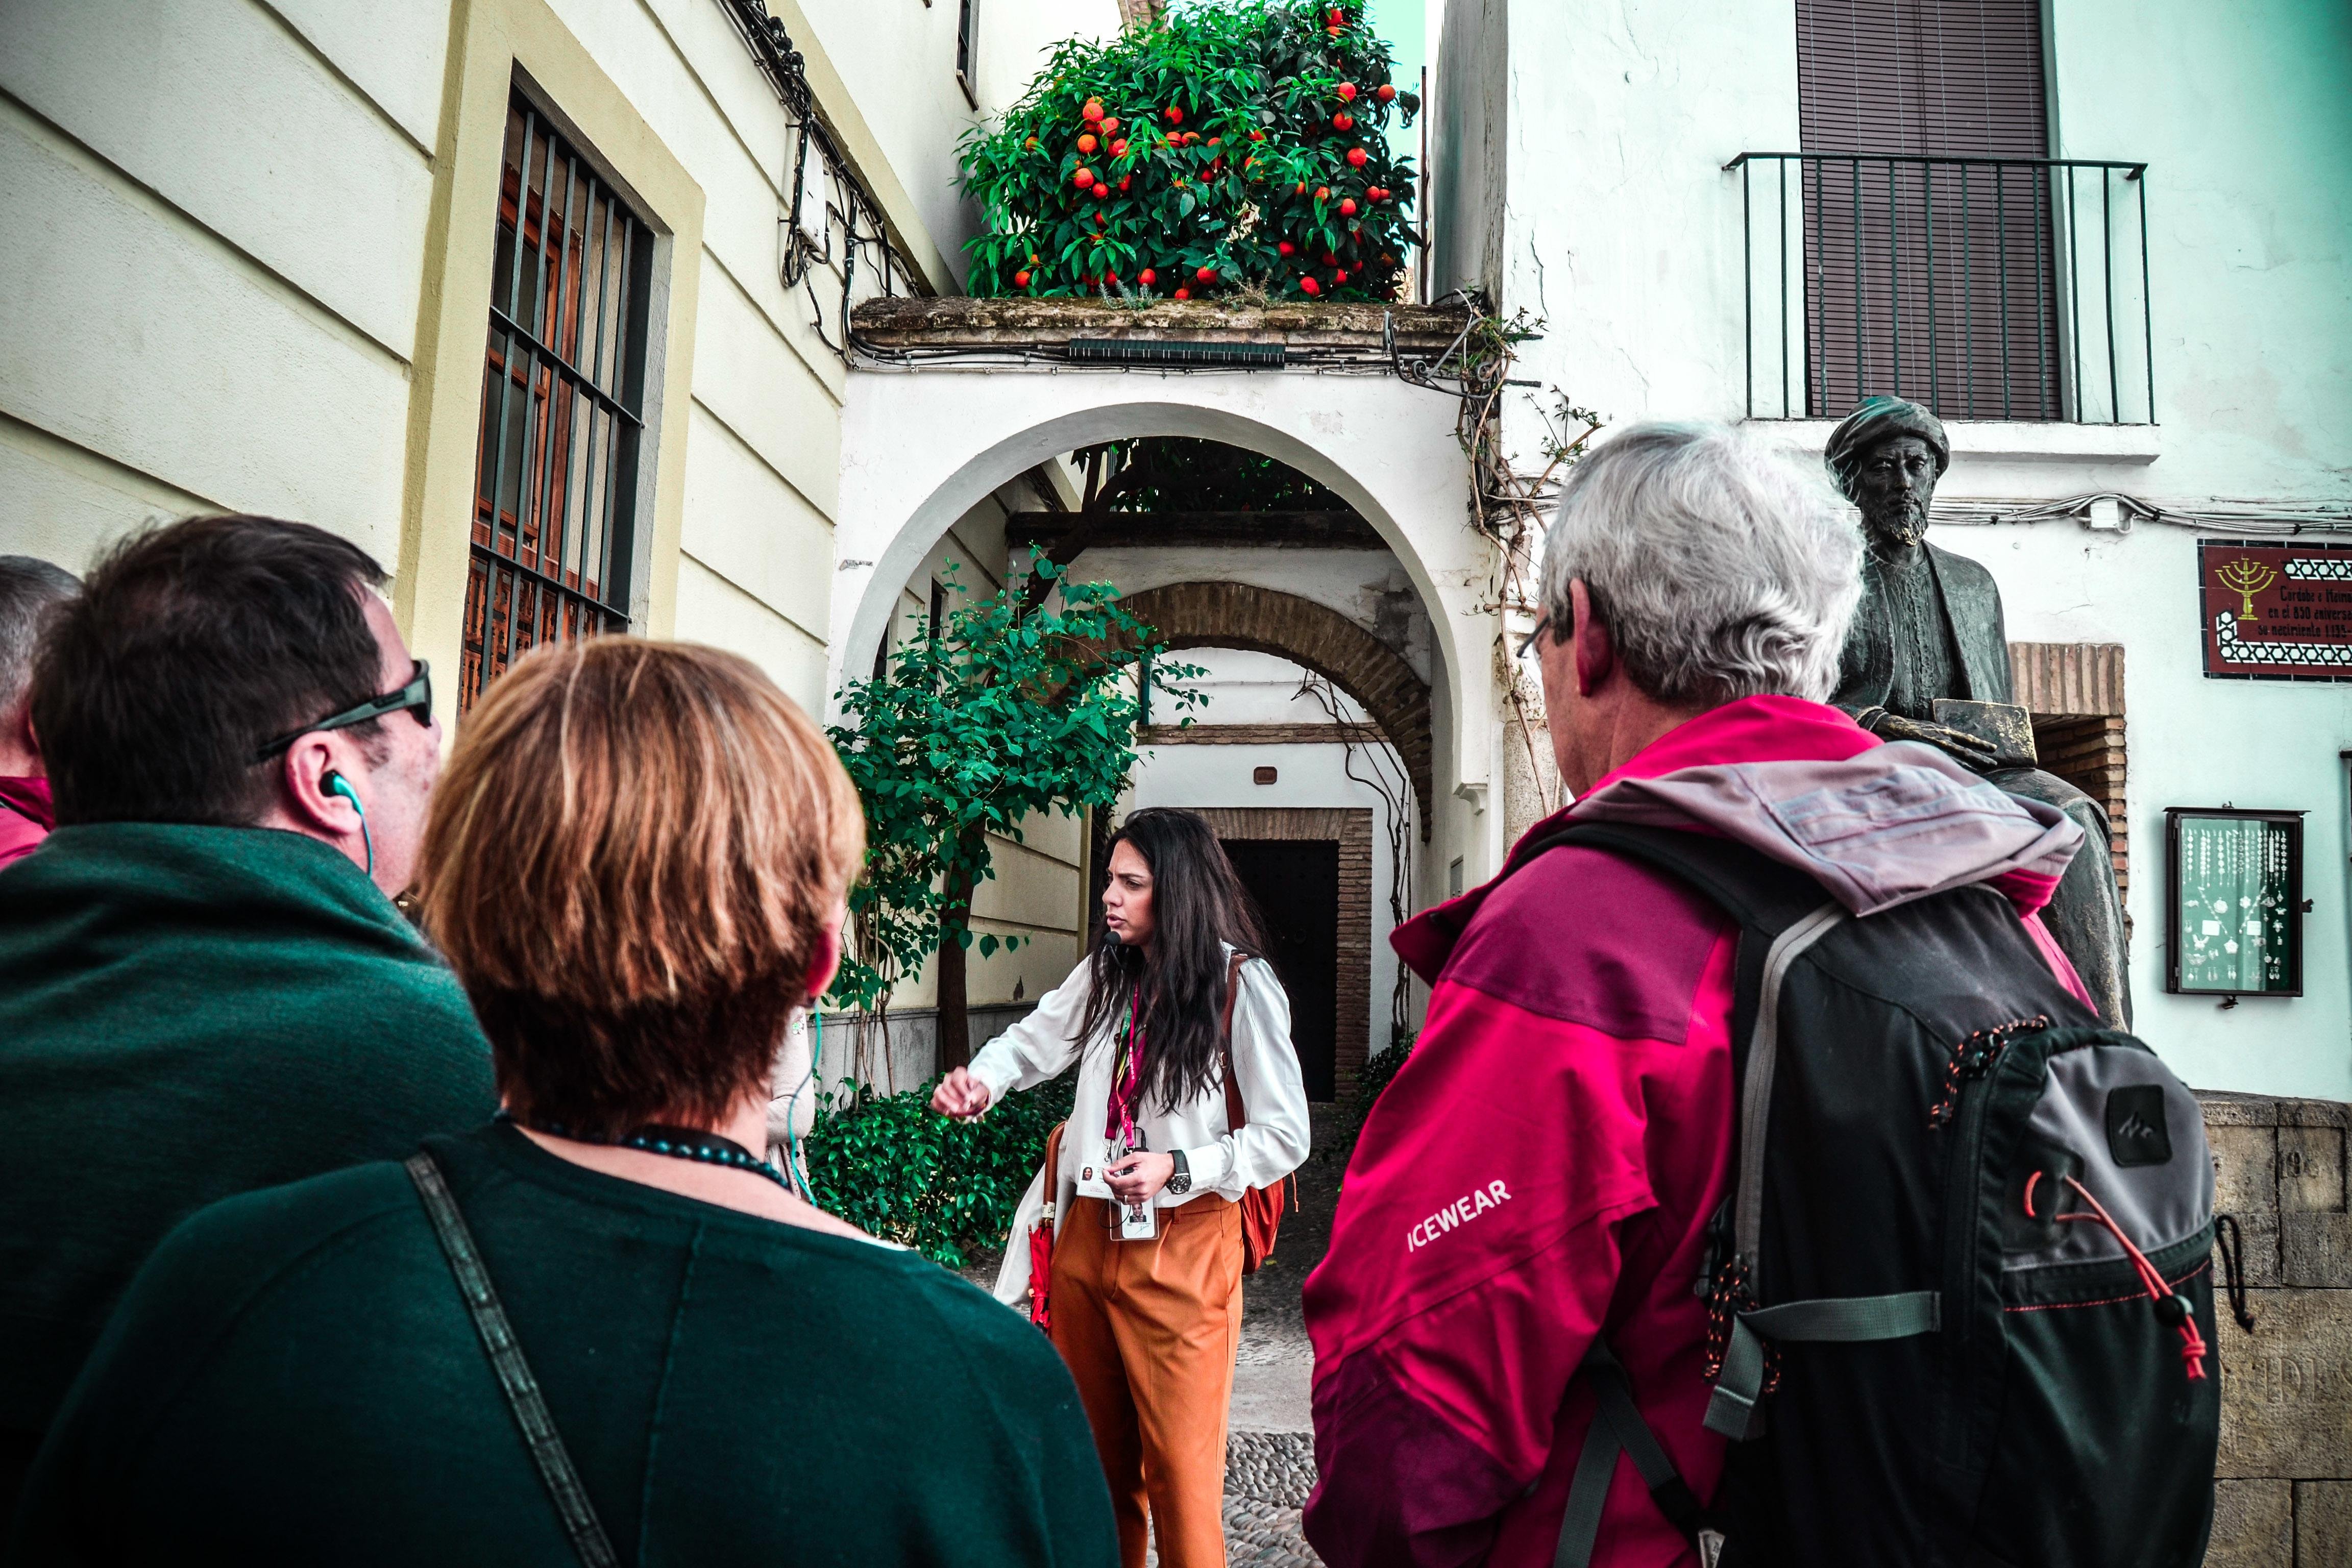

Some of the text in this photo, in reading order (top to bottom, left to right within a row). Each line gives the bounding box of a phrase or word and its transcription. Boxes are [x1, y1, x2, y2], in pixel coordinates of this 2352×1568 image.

[2268, 608, 2279, 618] en
[2282, 605, 2290, 619] el
[2272, 622, 2321, 636] nacimiento
[1407, 1180, 1512, 1253] ICEWEAR
